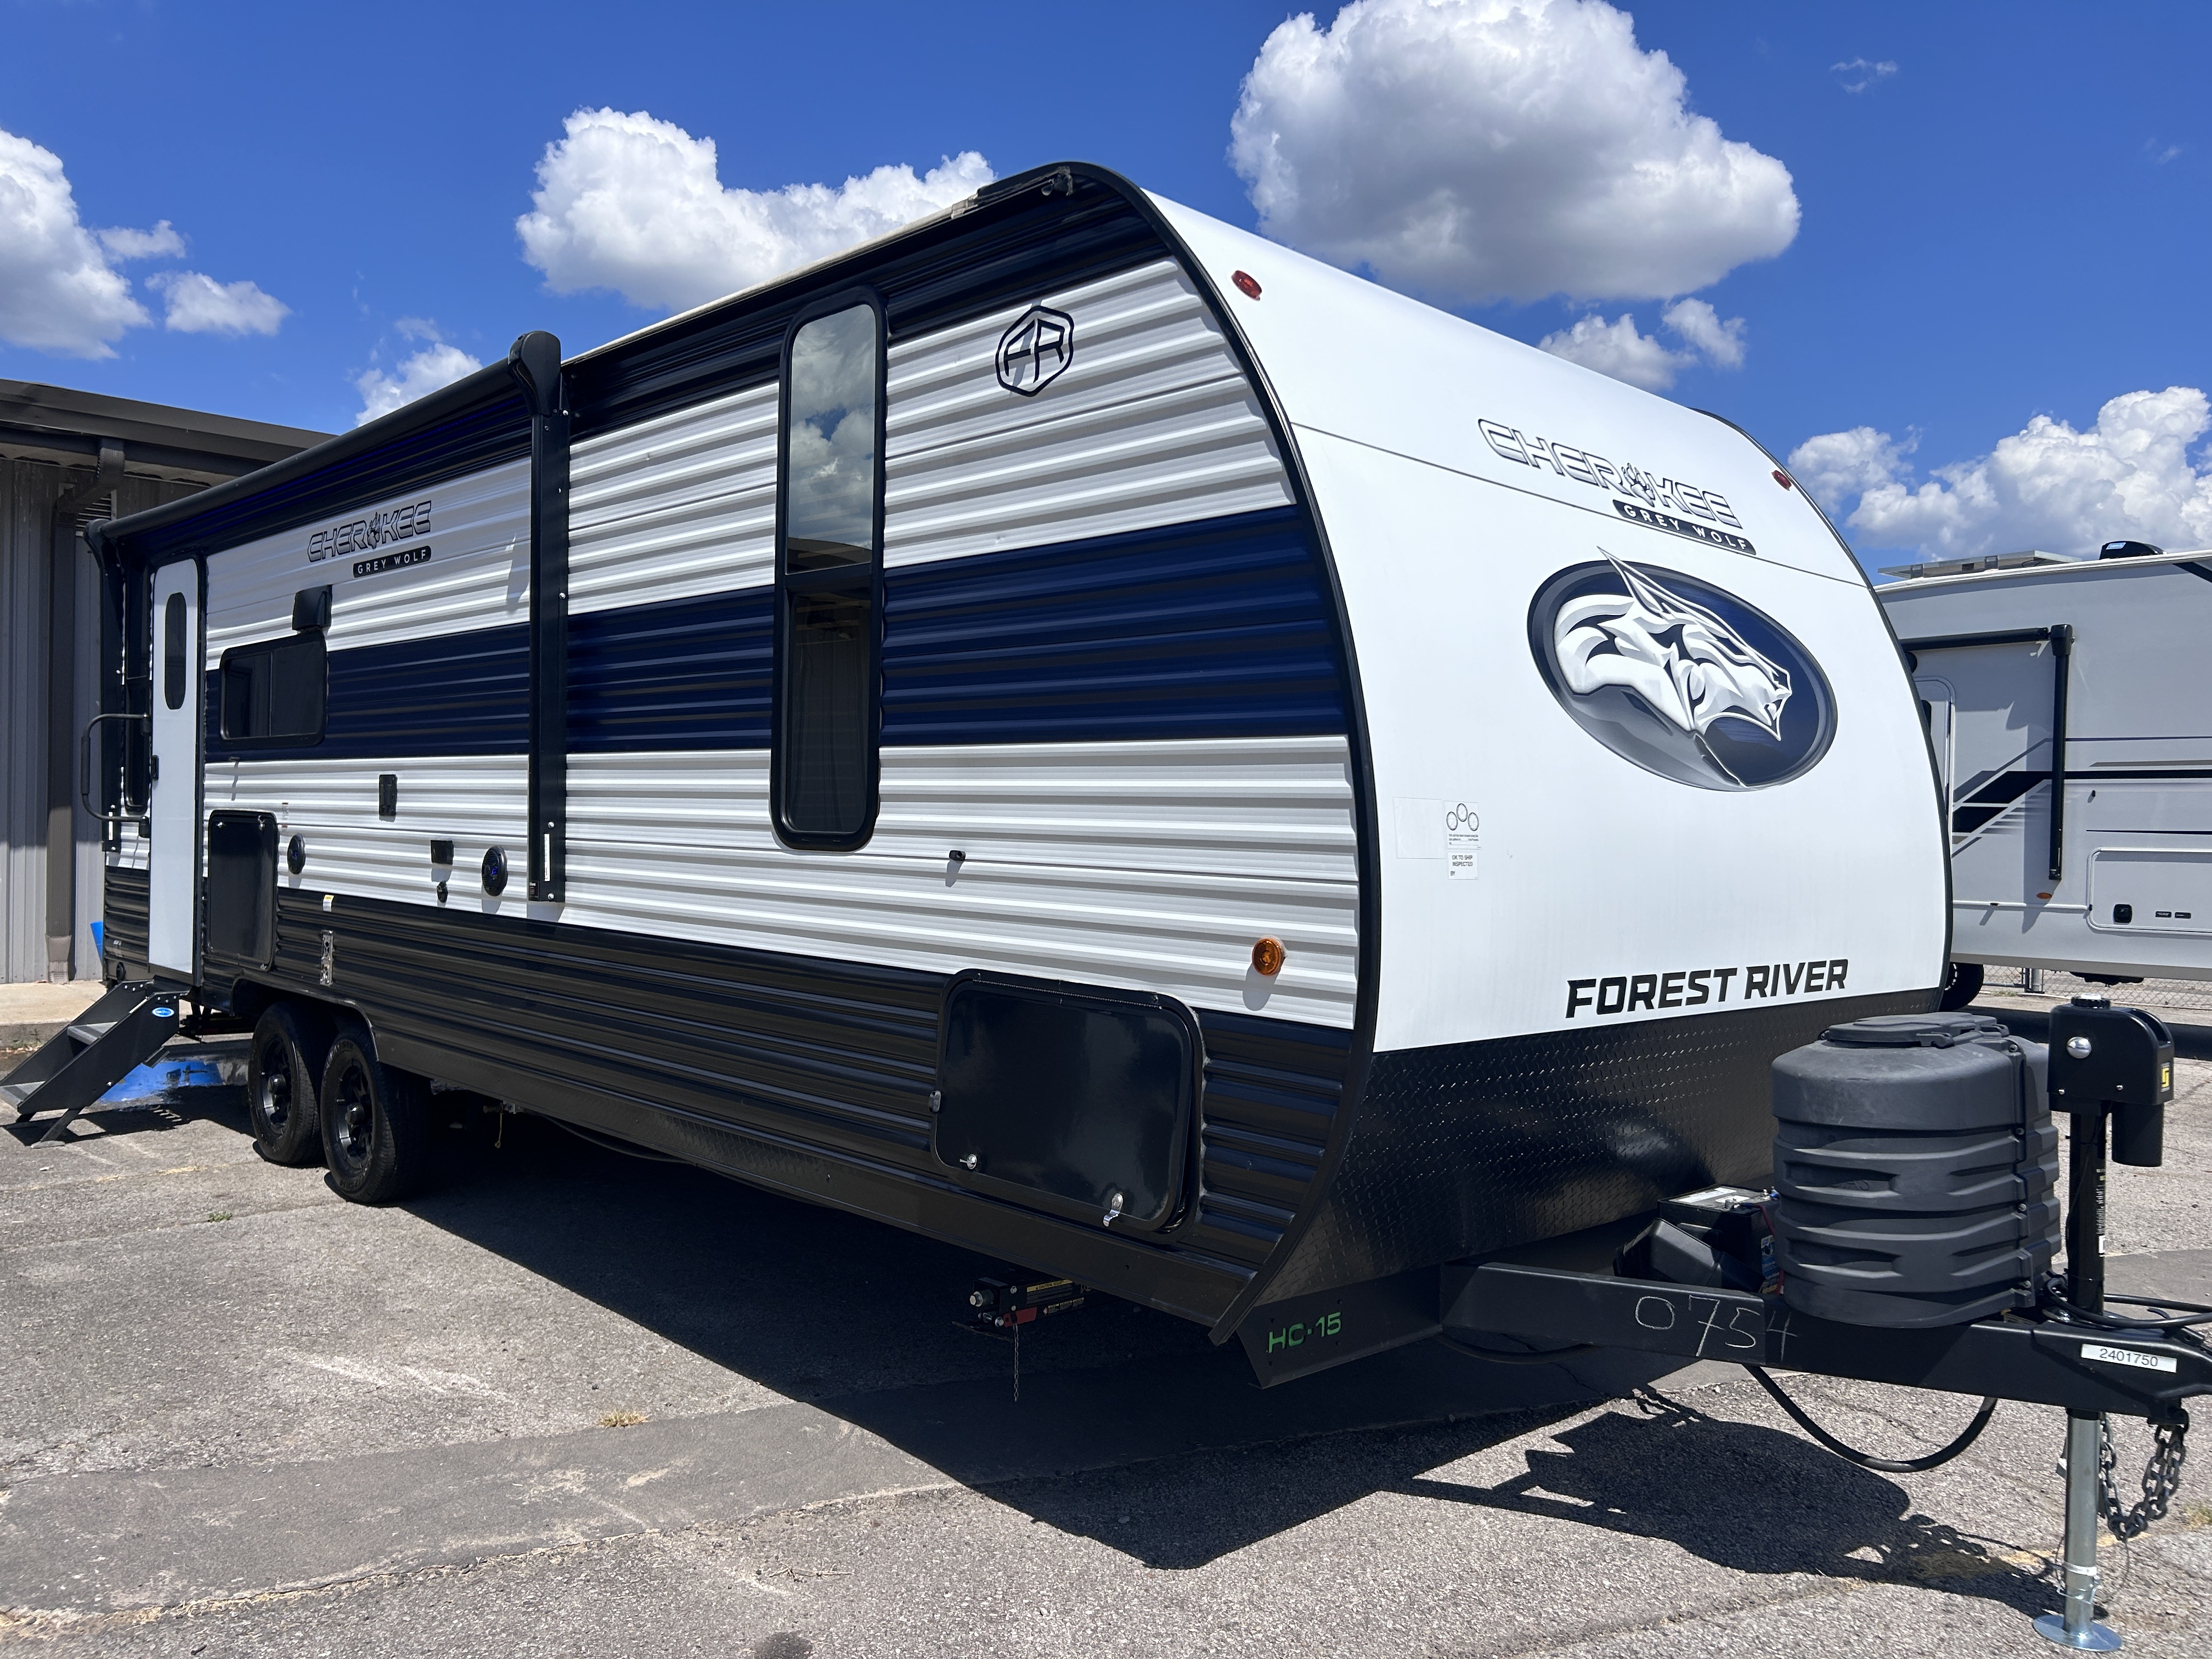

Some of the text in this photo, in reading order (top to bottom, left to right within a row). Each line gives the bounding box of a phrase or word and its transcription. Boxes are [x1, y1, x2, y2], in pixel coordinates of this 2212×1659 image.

[1623, 504, 1748, 550] GREY WOLF
[358, 549, 426, 574] GREY WOLF
[1565, 958, 1848, 1019] FOREST RIVER
[2099, 1348, 2159, 1367] 2401750
